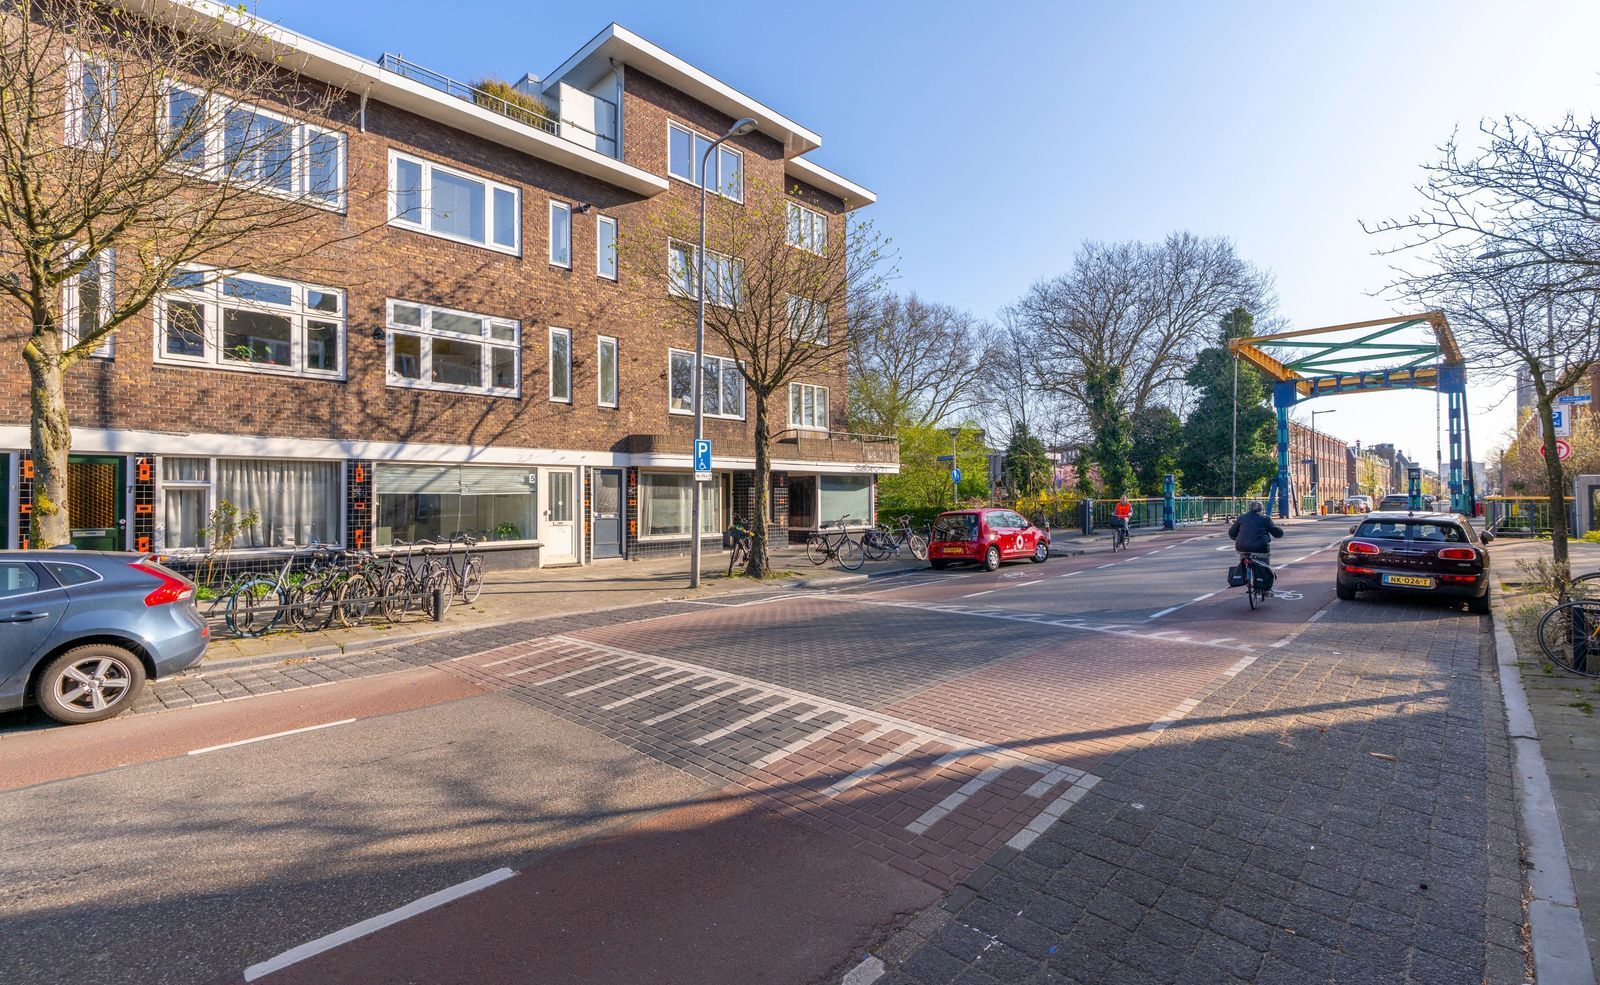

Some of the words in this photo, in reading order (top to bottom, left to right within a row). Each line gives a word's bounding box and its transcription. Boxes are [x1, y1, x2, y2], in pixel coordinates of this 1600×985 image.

[698, 442, 708, 458] P
[135, 457, 144, 465] 7
[530, 474, 536, 483] 5
[1390, 576, 1428, 585] NK-026-T
